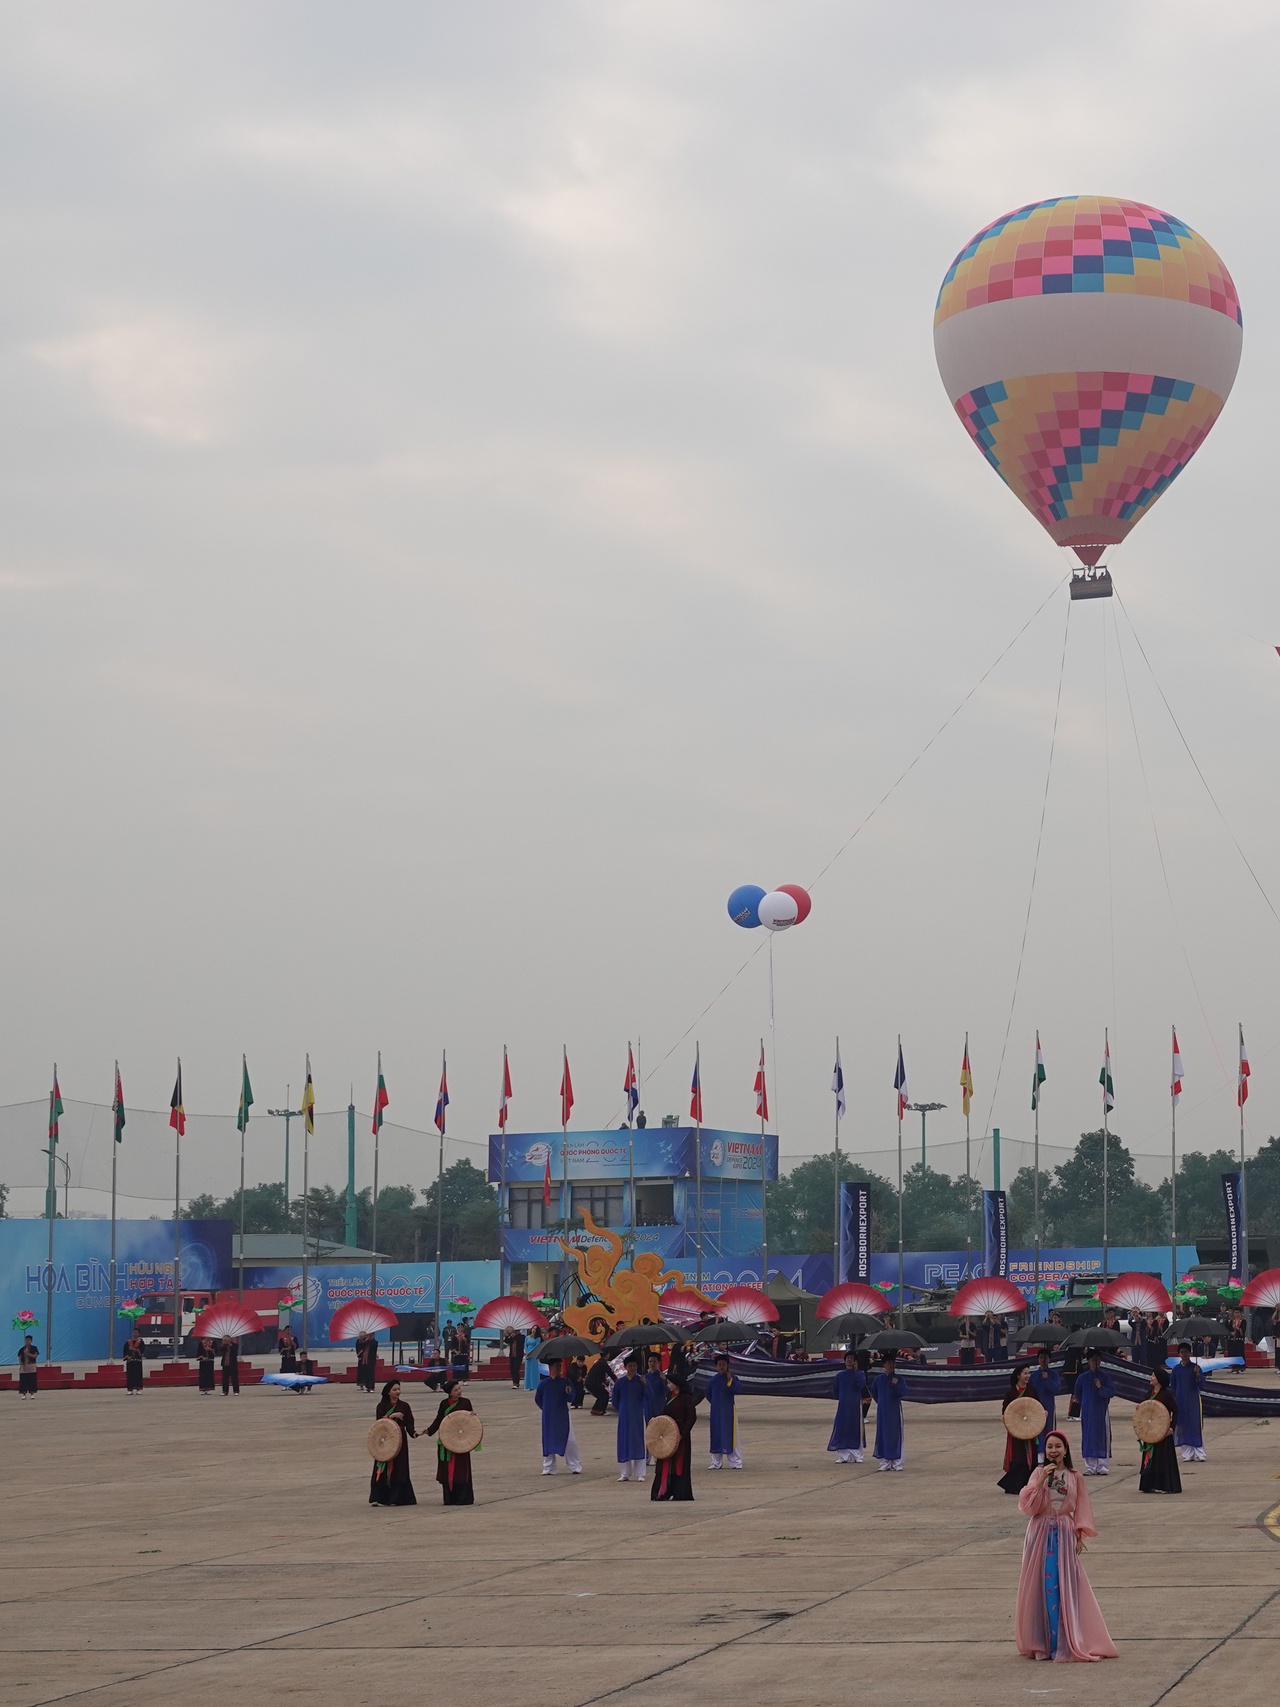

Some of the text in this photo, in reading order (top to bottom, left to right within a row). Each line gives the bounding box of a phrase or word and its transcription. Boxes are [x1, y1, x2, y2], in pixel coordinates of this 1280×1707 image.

[578, 1147, 600, 1155] PHÒNG
[601, 1146, 619, 1155] QUỐC
[743, 1156, 762, 1170] 2024
[1225, 1181, 1238, 1270] ROSOBORNEXPORT
[858, 1189, 868, 1278] ROSOBORNEXPORT
[998, 1197, 1007, 1276] ROSOBORNEXPORT
[129, 1260, 154, 1275] HỮU
[1009, 1260, 1101, 1272] FRIENDSHIP
[25, 1257, 129, 1293] HÒA BÌNH
[129, 1277, 154, 1292] HỢP
[328, 1284, 424, 1299] QUỐC PHÒNG QUỐC TẾ
